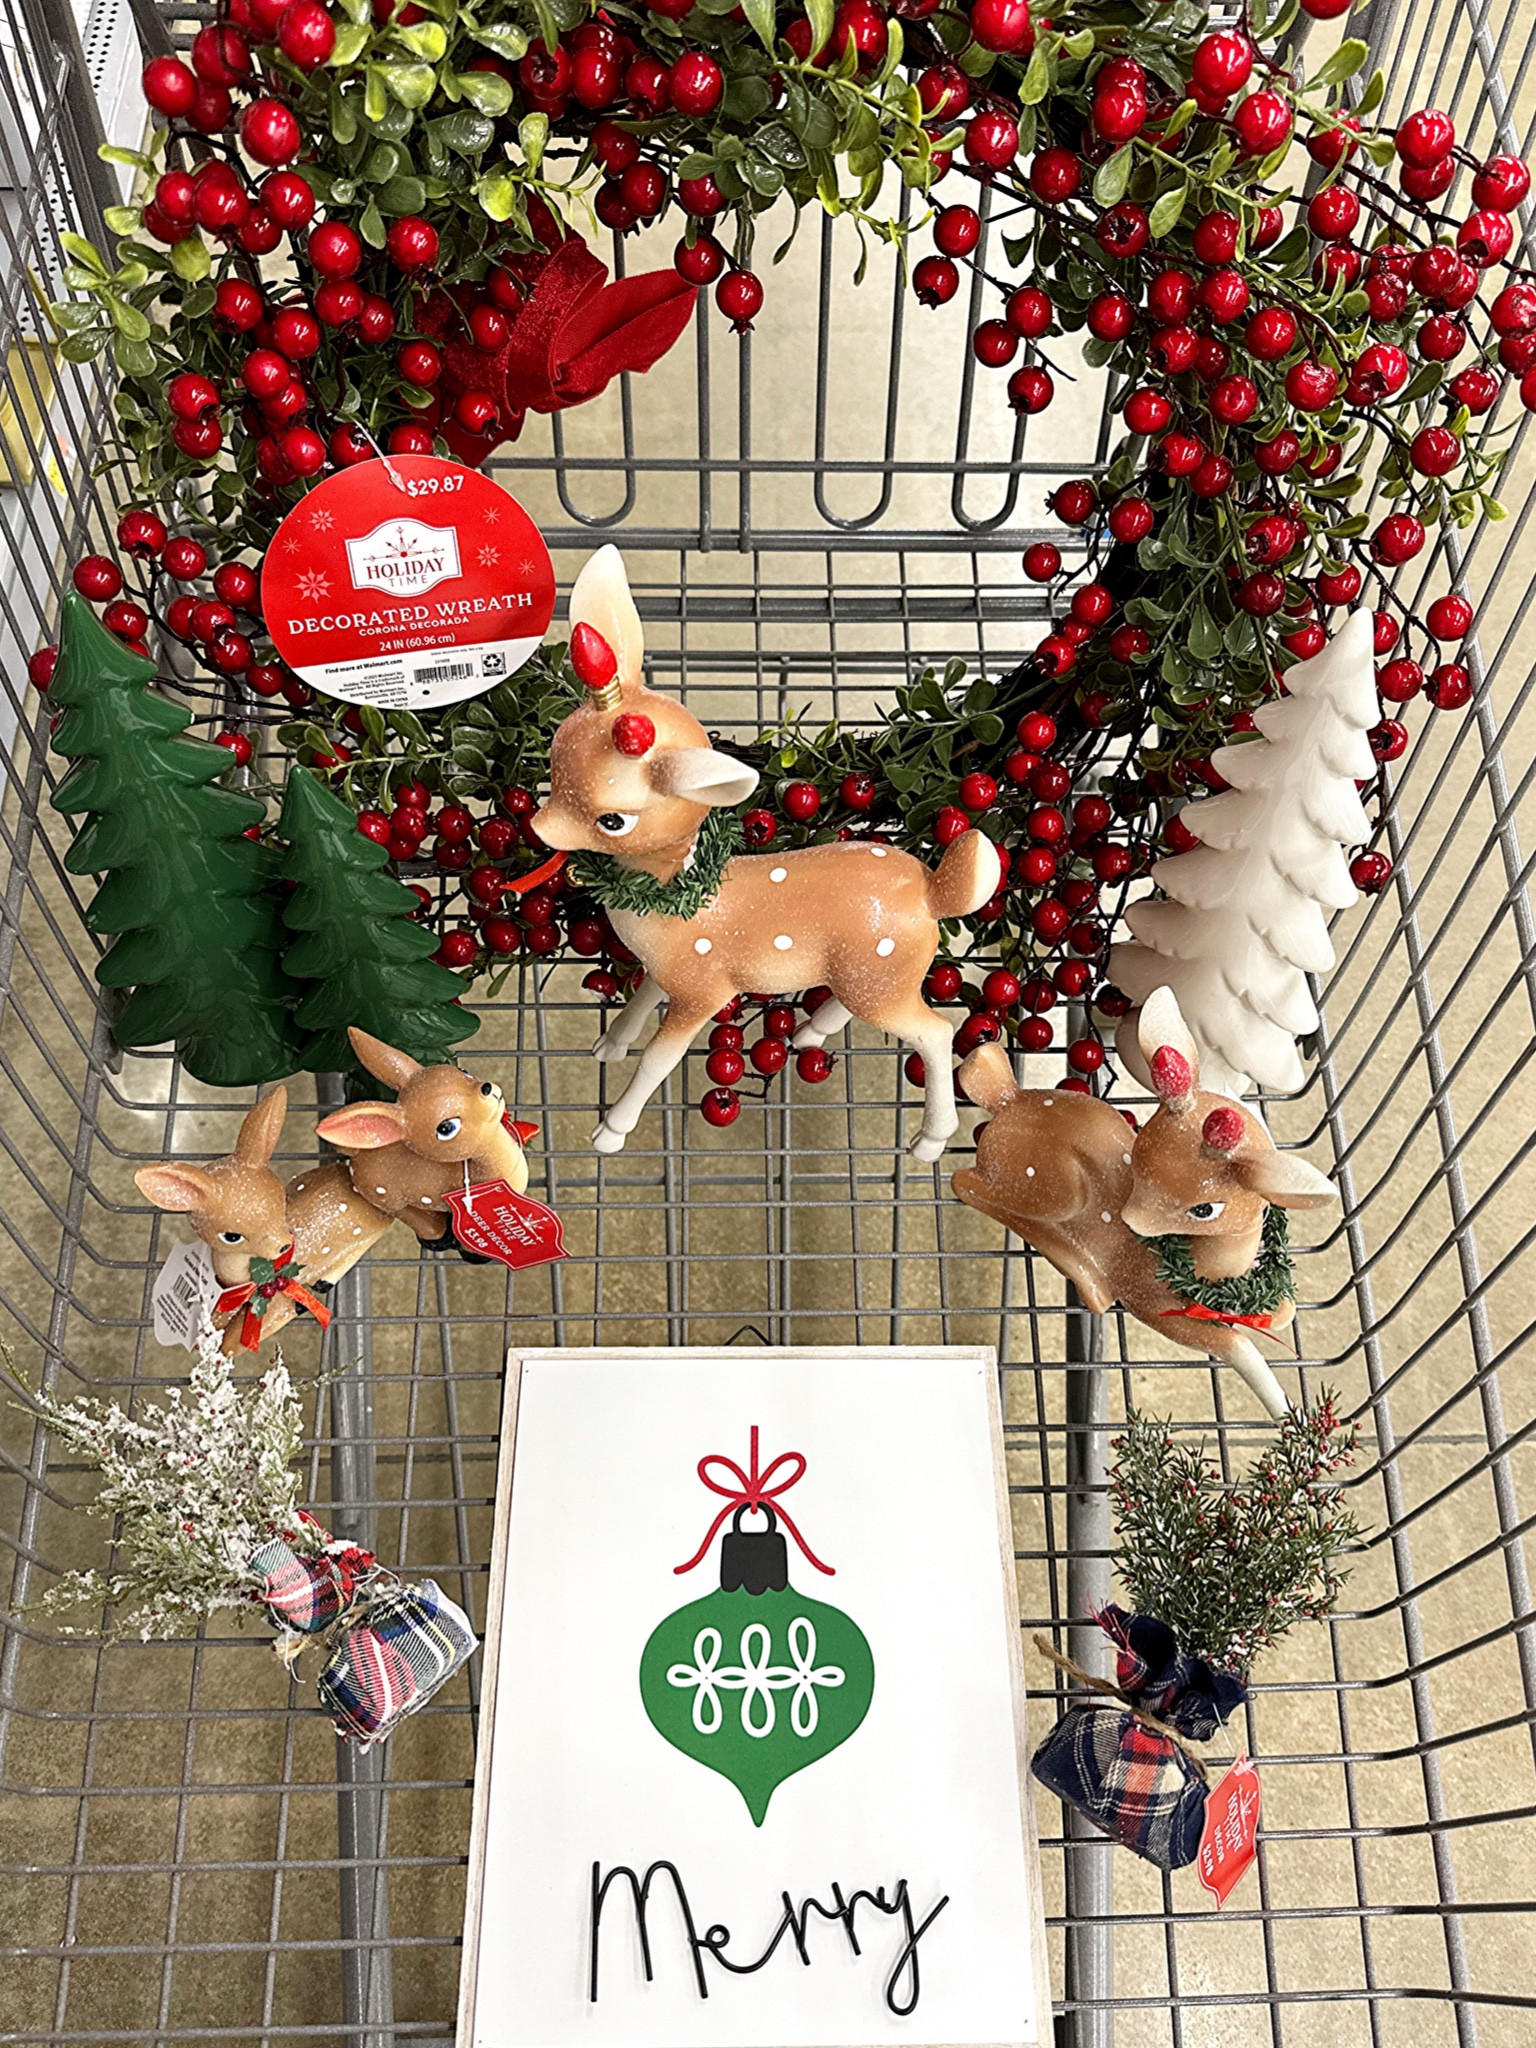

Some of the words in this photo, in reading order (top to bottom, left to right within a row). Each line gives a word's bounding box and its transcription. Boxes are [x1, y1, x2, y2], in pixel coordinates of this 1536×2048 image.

[406, 475, 465, 498] $29.87
[366, 557, 446, 580] HOLIDAY
[388, 575, 429, 588] TIME
[288, 606, 430, 635] DECORATED
[435, 592, 533, 617] WREATH
[359, 623, 407, 637] CORONA
[409, 616, 470, 630] DECORADA
[379, 641, 392, 652] 24
[393, 639, 405, 649] IN
[405, 635, 436, 649] (60.96
[437, 632, 456, 644] cm)
[325, 667, 339, 675] Find
[363, 659, 403, 670] Walmart.com
[470, 1210, 491, 1232] DEER
[493, 1206, 537, 1246] HOLIDAY
[493, 1220, 516, 1242] TIME
[464, 1228, 489, 1249] $3.98
[1223, 1816, 1235, 1850] TIME
[1227, 1791, 1244, 1853] HOLIDAY
[1202, 1843, 1215, 1877] $2.98
[590, 1860, 950, 2016] Merry
